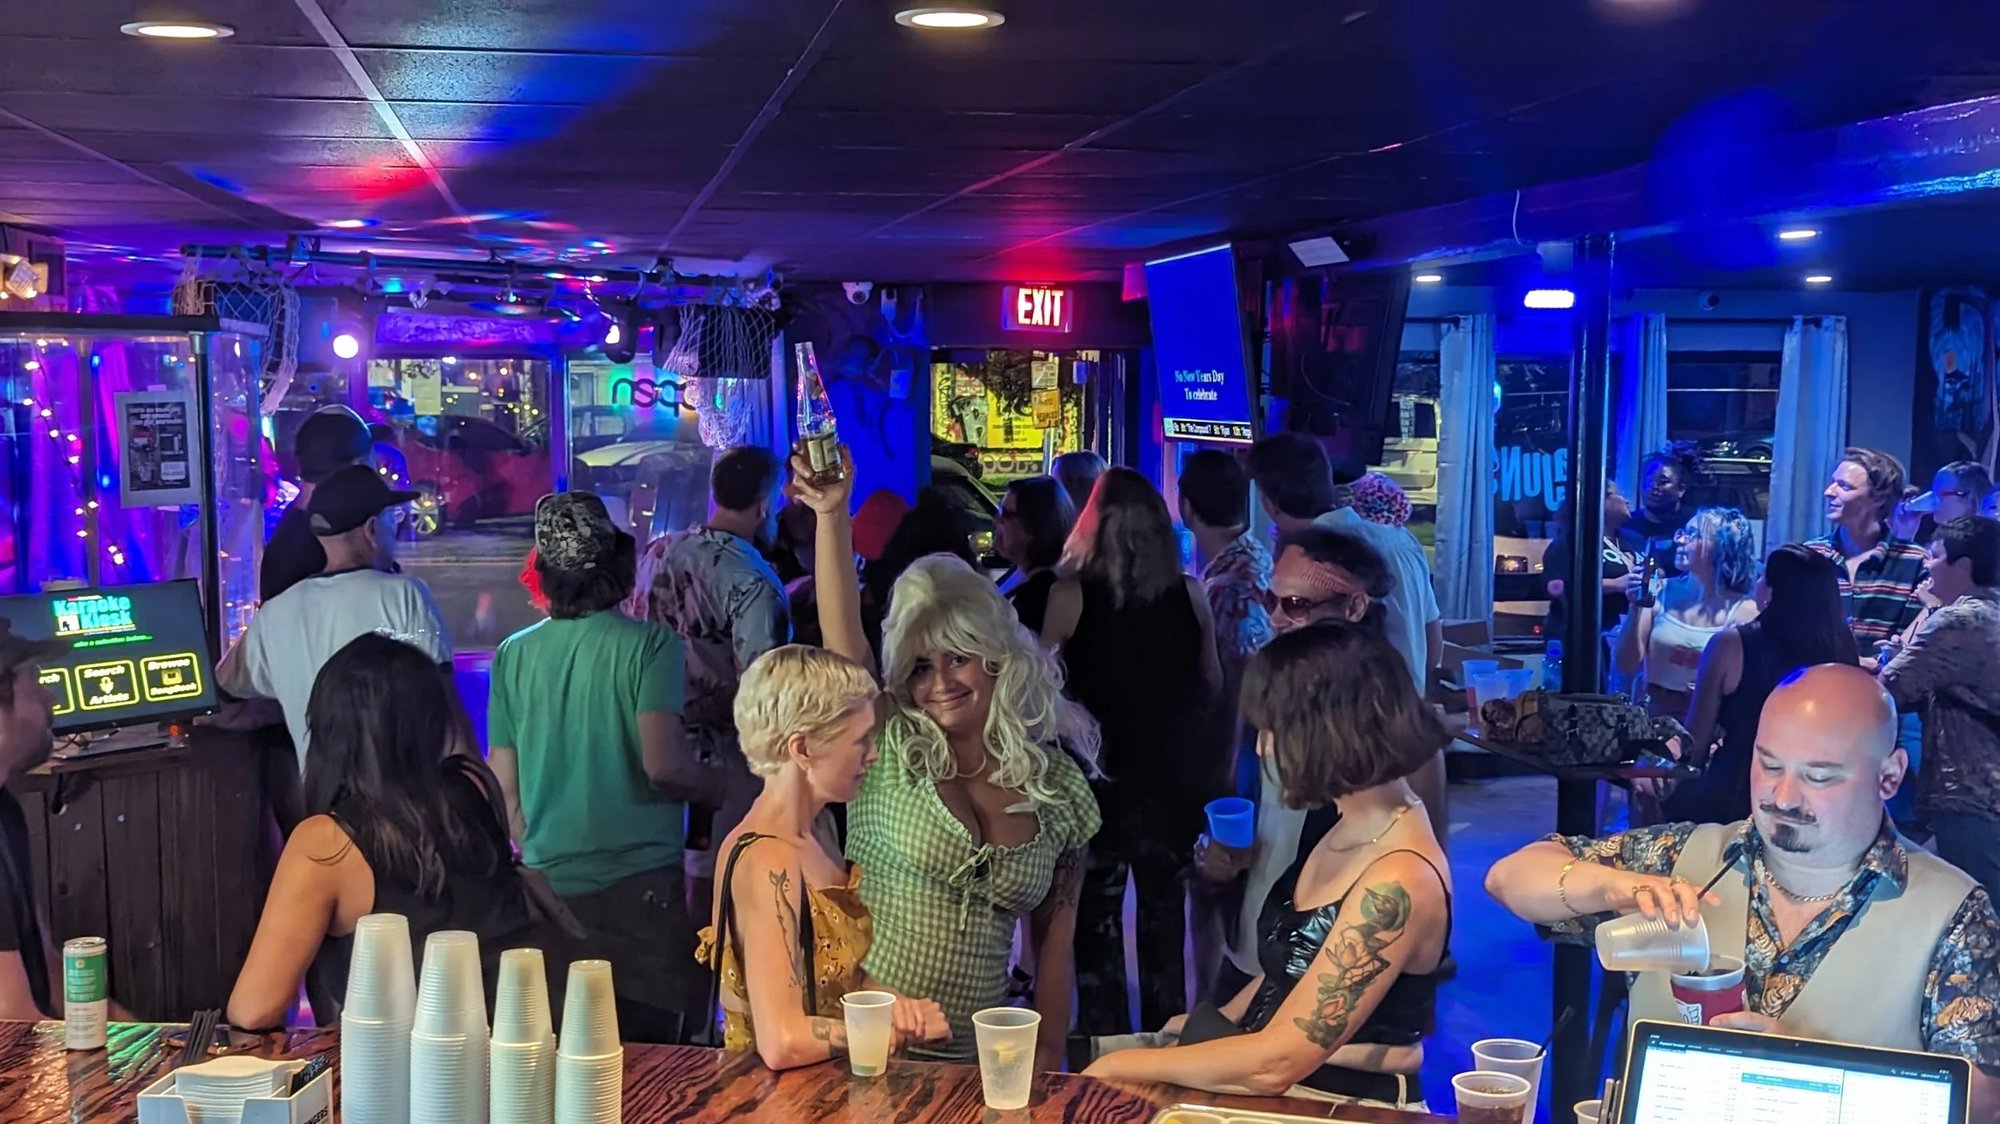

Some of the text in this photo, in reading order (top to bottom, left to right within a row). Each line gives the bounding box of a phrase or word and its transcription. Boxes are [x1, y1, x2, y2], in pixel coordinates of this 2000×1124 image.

[1017, 287, 1064, 327] EXIT
[1212, 369, 1225, 386] Day
[1184, 388, 1218, 400] To celebrate
[53, 595, 131, 617] Karaoke
[80, 610, 133, 629] Kiosk
[83, 665, 125, 679] Search
[148, 658, 191, 671] Browse
[89, 691, 130, 706] Artists
